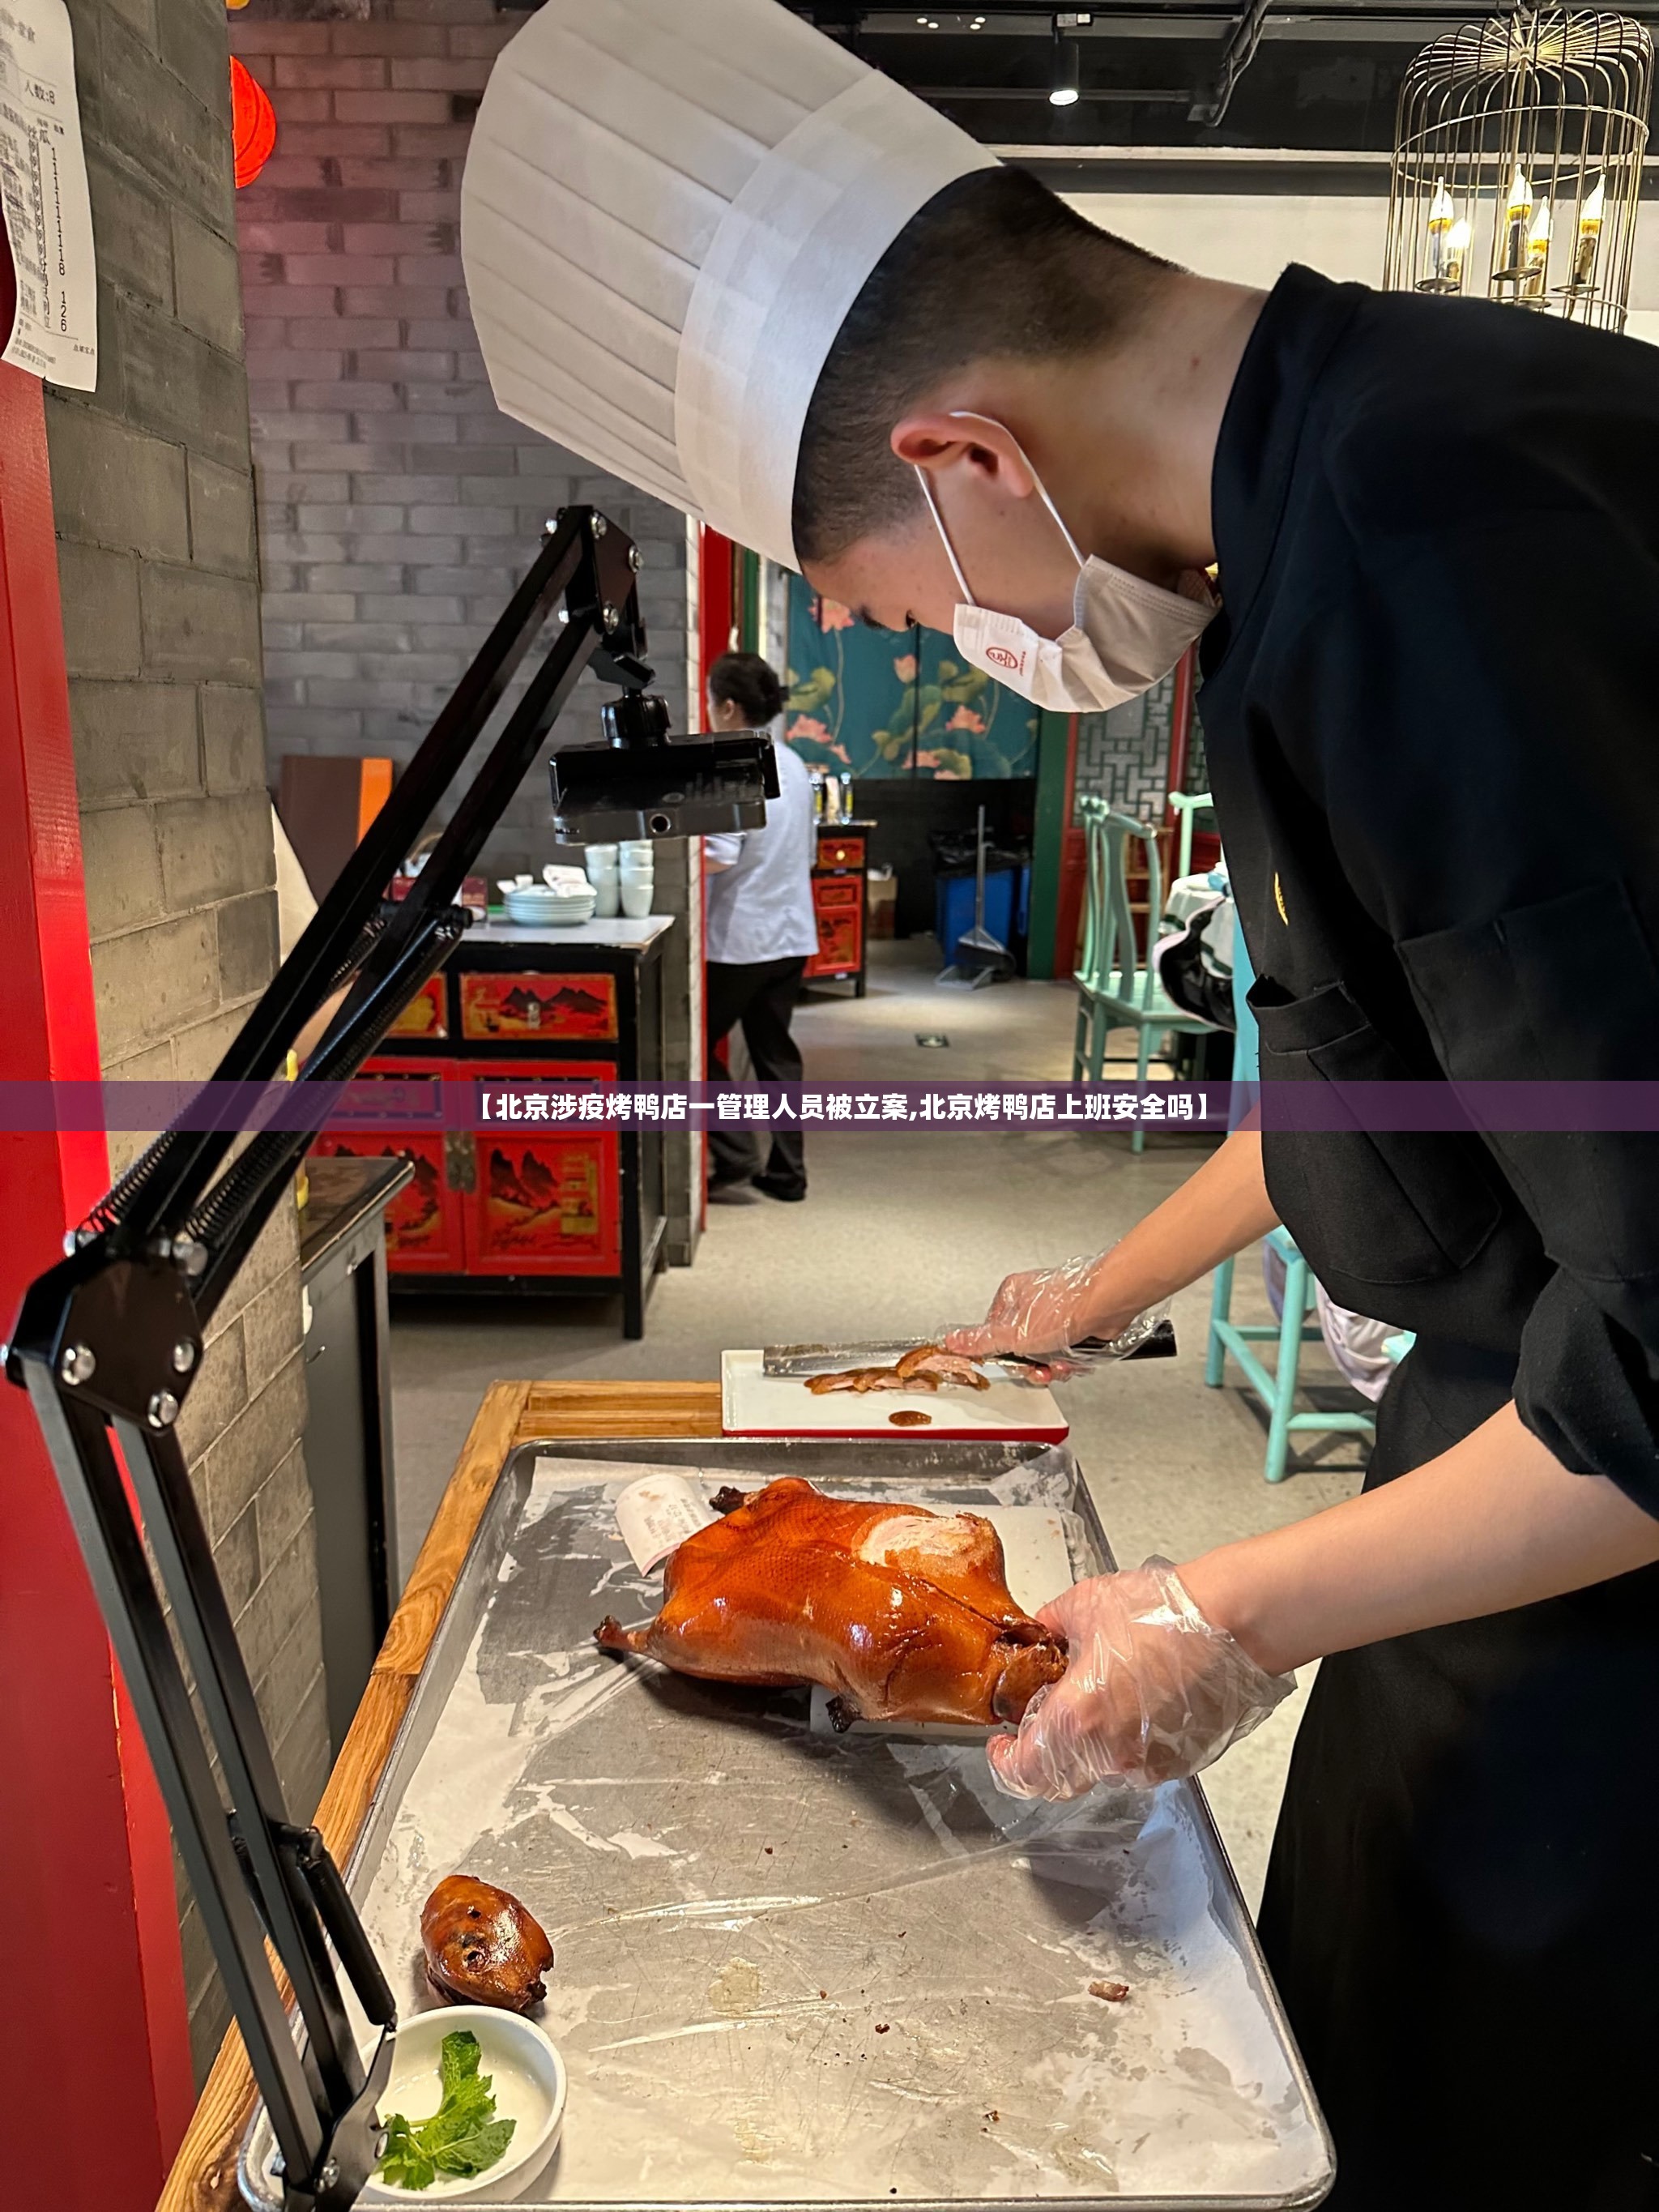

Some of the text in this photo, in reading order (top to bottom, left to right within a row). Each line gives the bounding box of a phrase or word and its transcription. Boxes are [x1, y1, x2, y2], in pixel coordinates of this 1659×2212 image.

[25, 79, 55, 105] 人数:8
[58, 263, 66, 276] 8
[61, 305, 66, 318] 2
[61, 318, 67, 332] 6
